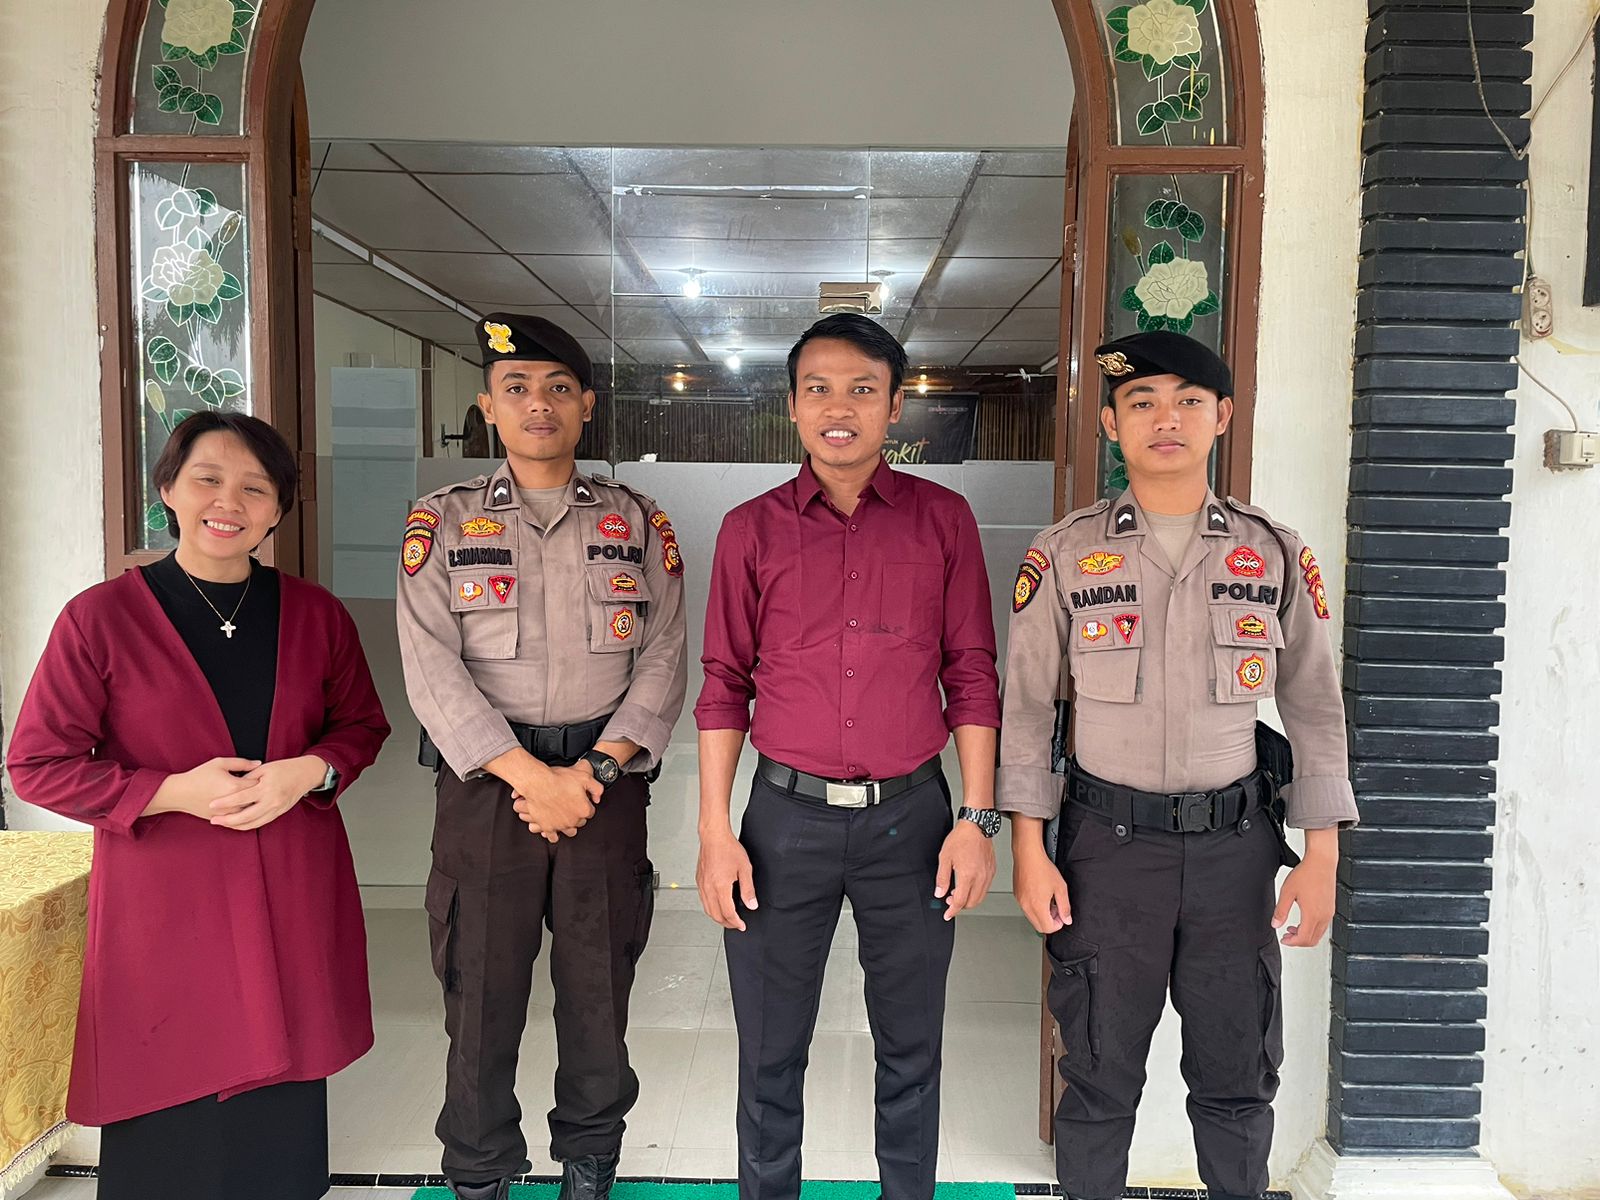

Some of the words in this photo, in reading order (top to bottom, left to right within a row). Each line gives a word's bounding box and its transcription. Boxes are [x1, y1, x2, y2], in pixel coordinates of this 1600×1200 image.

[587, 544, 643, 564] POLRI
[1070, 584, 1137, 609] RAMDAN
[1211, 582, 1279, 605] POLRI
[1076, 780, 1111, 810] POL
